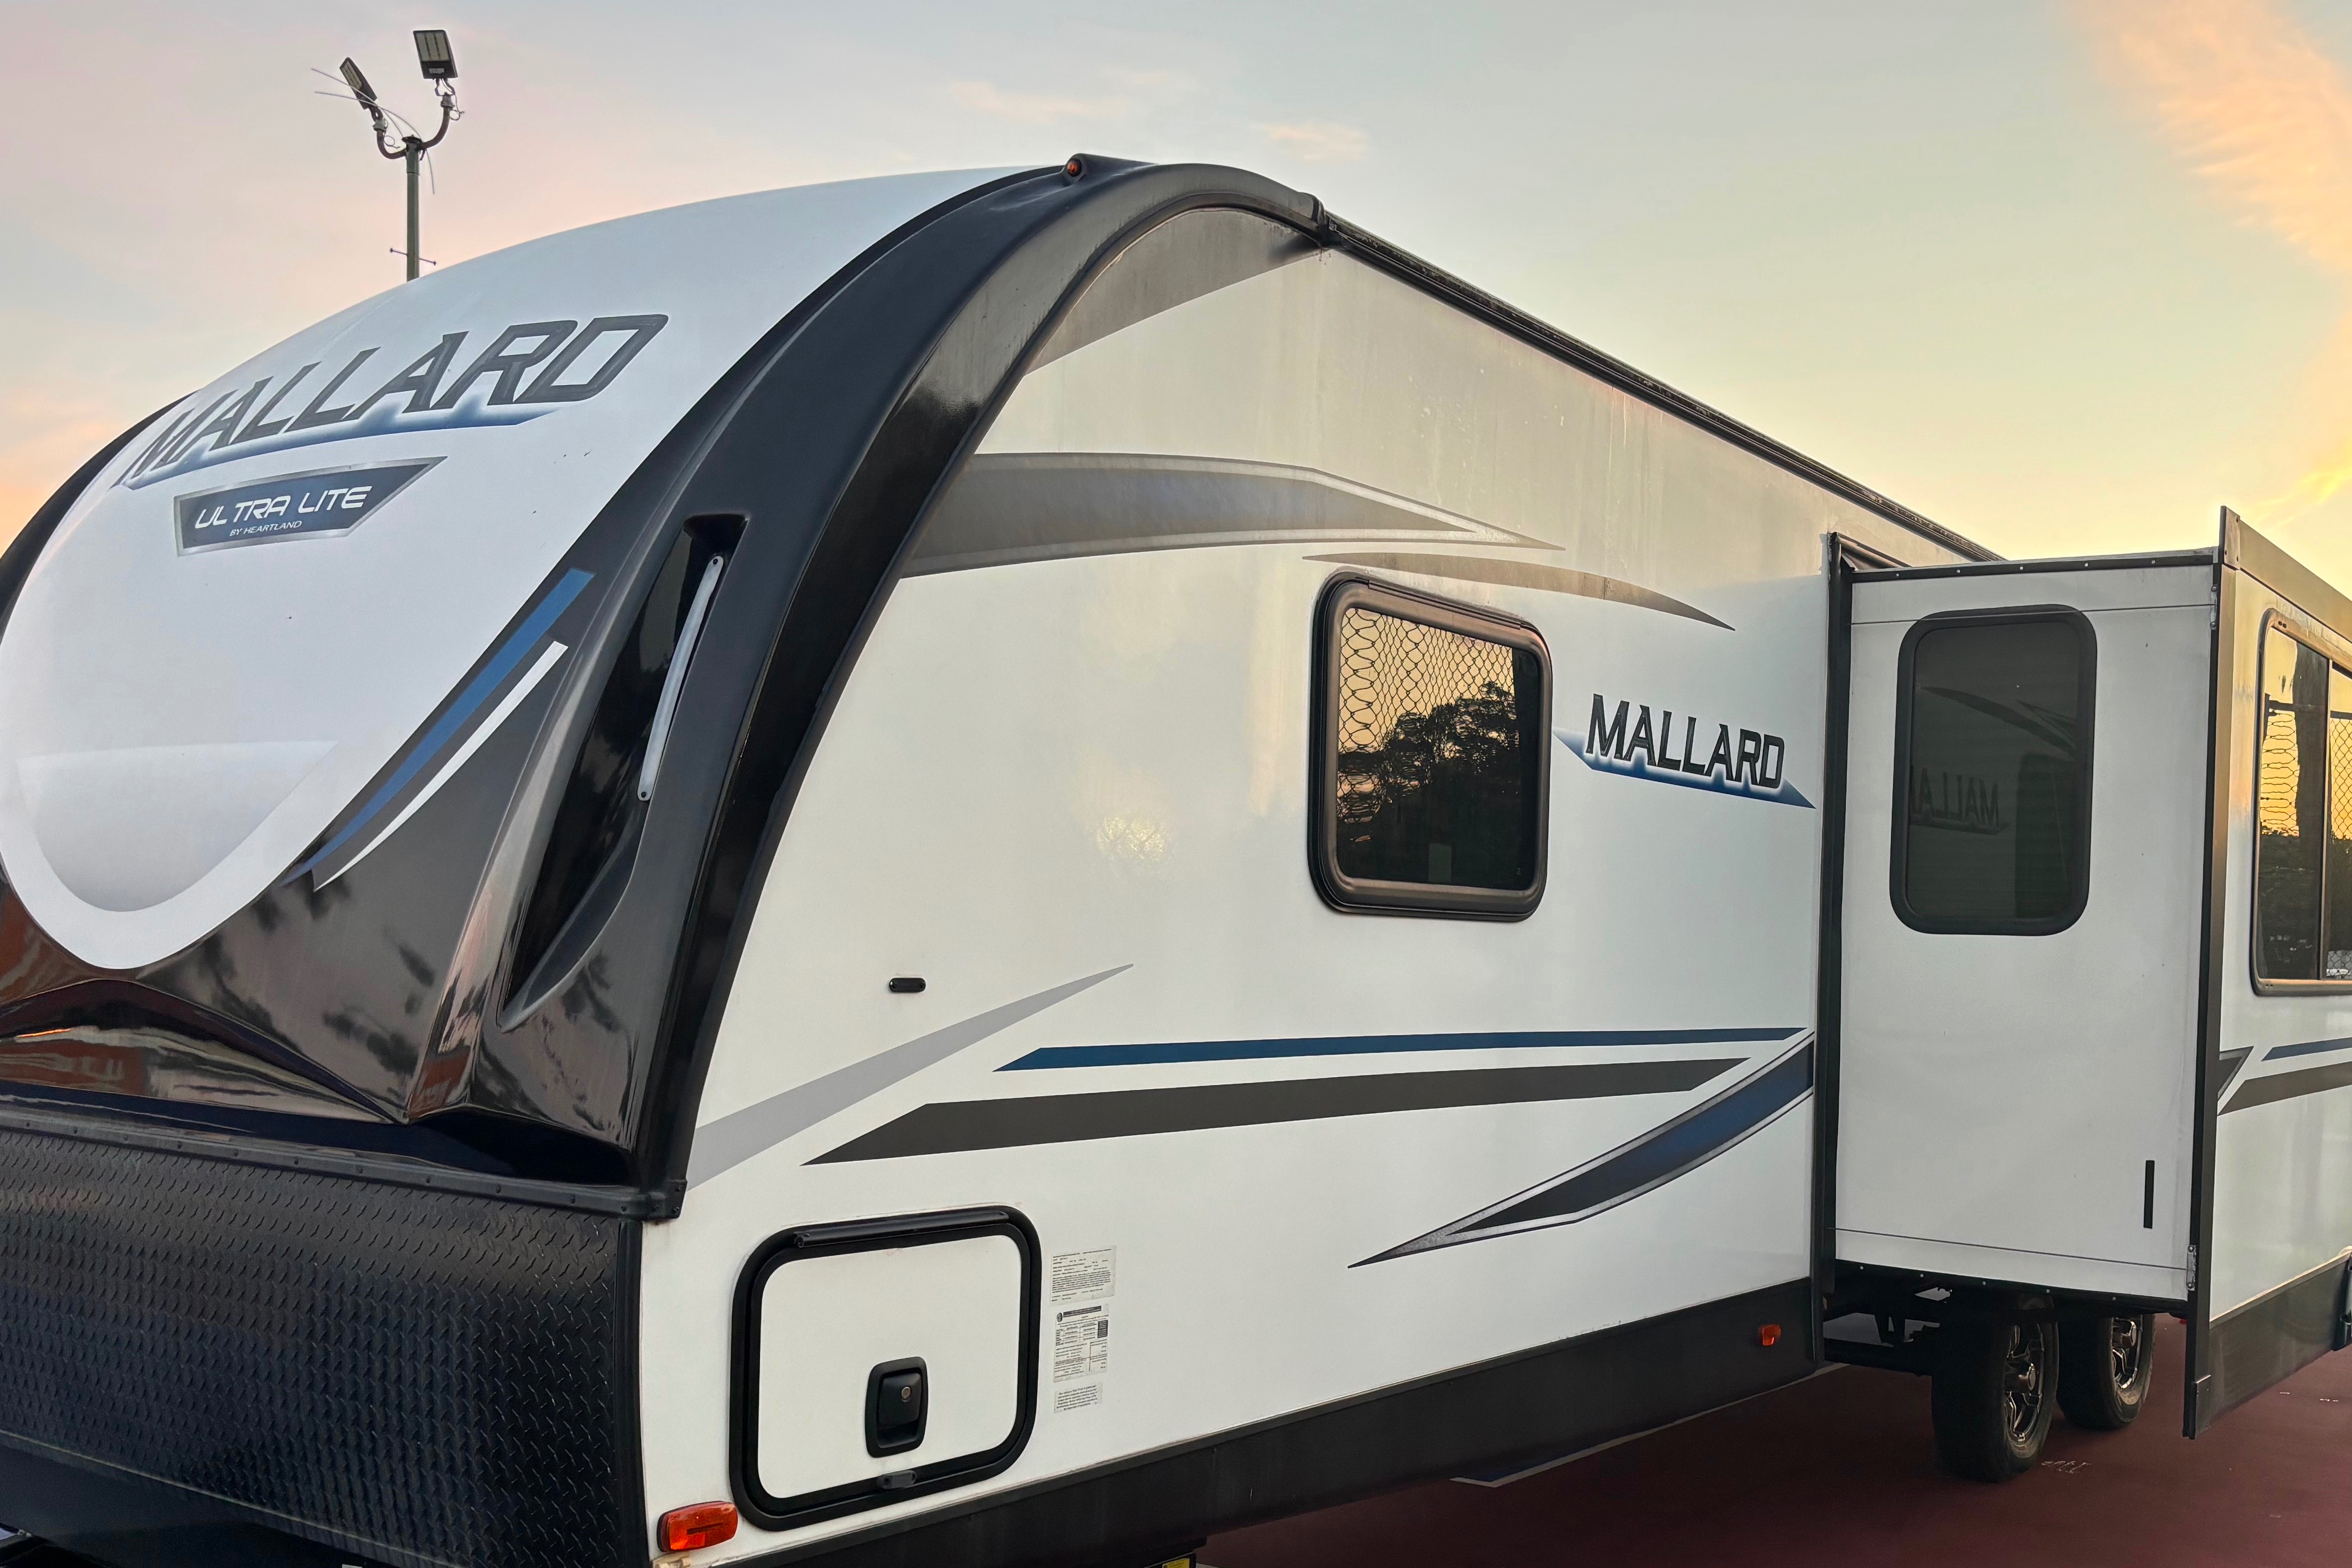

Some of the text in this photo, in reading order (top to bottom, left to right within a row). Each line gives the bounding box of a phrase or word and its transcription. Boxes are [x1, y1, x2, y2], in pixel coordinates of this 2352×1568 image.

[109, 314, 669, 489] MALLARD
[195, 486, 373, 529] ULTRA LITE
[229, 520, 302, 536] BY HEARTLAND
[1585, 693, 1785, 789] MALLARD
